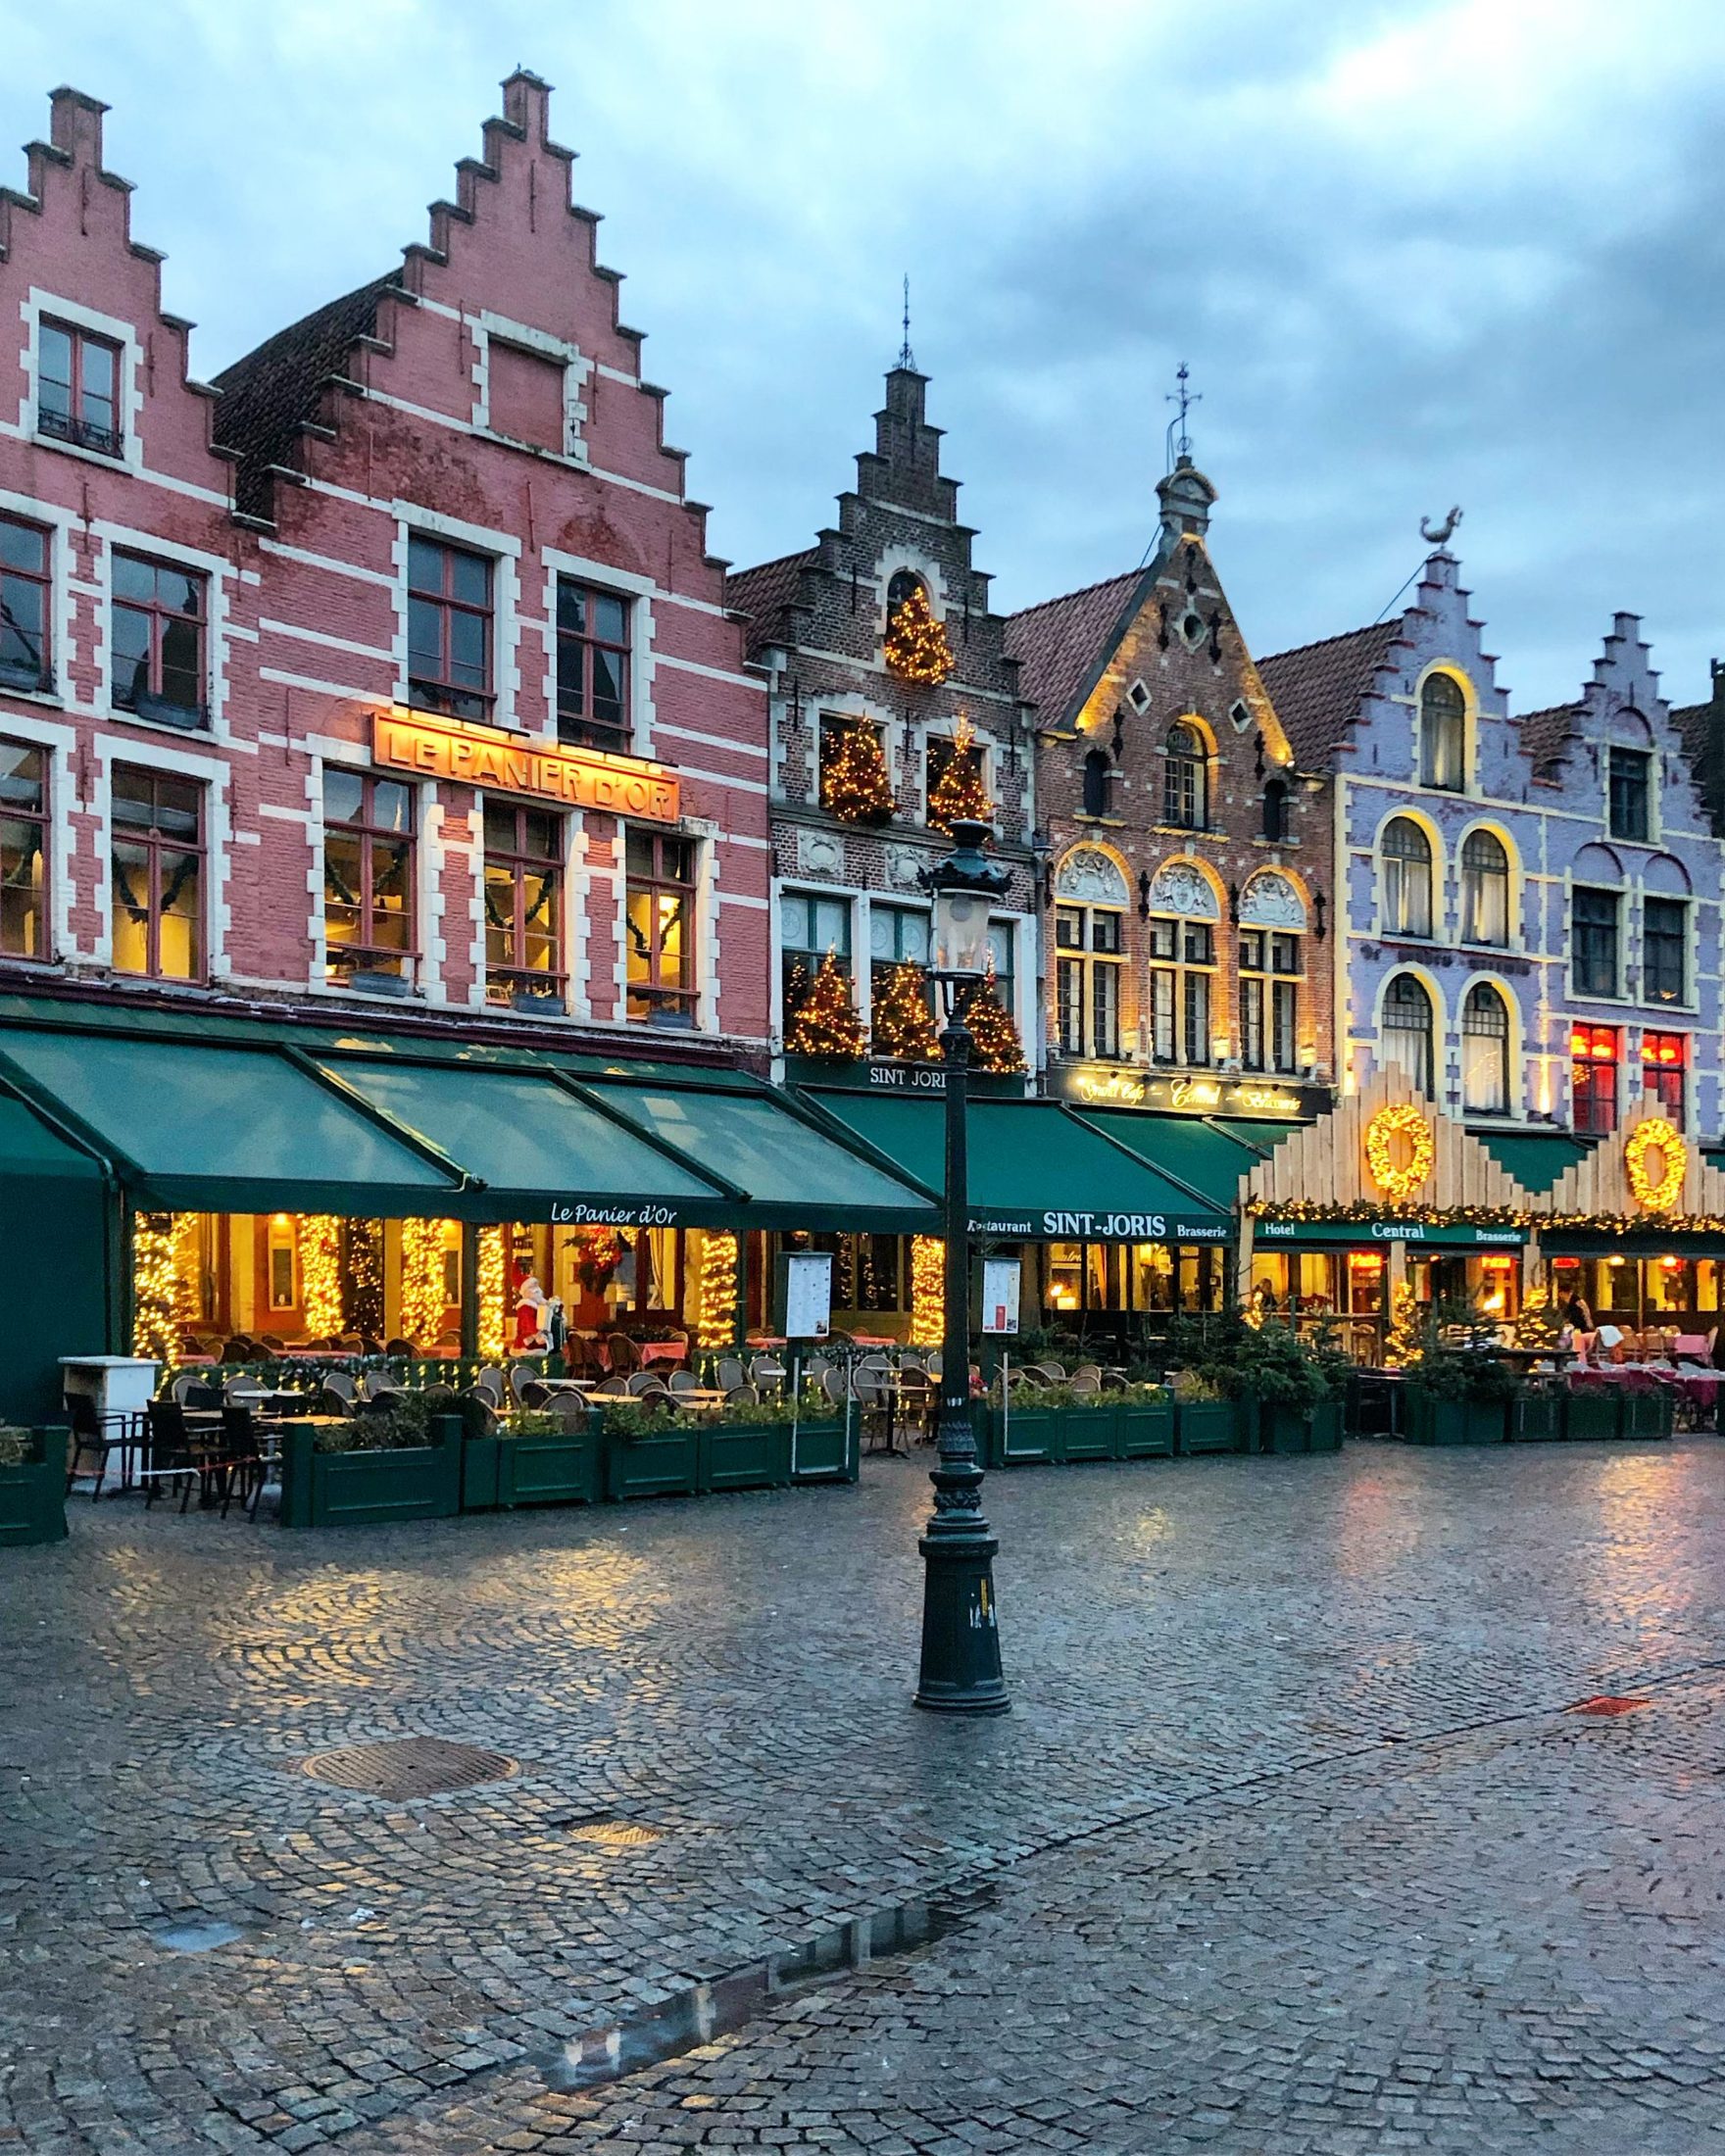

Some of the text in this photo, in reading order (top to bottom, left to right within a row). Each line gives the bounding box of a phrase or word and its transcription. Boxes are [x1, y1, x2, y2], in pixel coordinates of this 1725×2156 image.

[389, 733, 670, 817] LE PANIER D'OR
[869, 1067, 947, 1089] SINT JORI
[551, 1202, 677, 1224] Le Panier d'Or
[1043, 1211, 1166, 1237] SINT-JORIS
[1177, 1224, 1227, 1238] Brasserie
[1264, 1223, 1522, 1242] Hotel Central Brasserie
